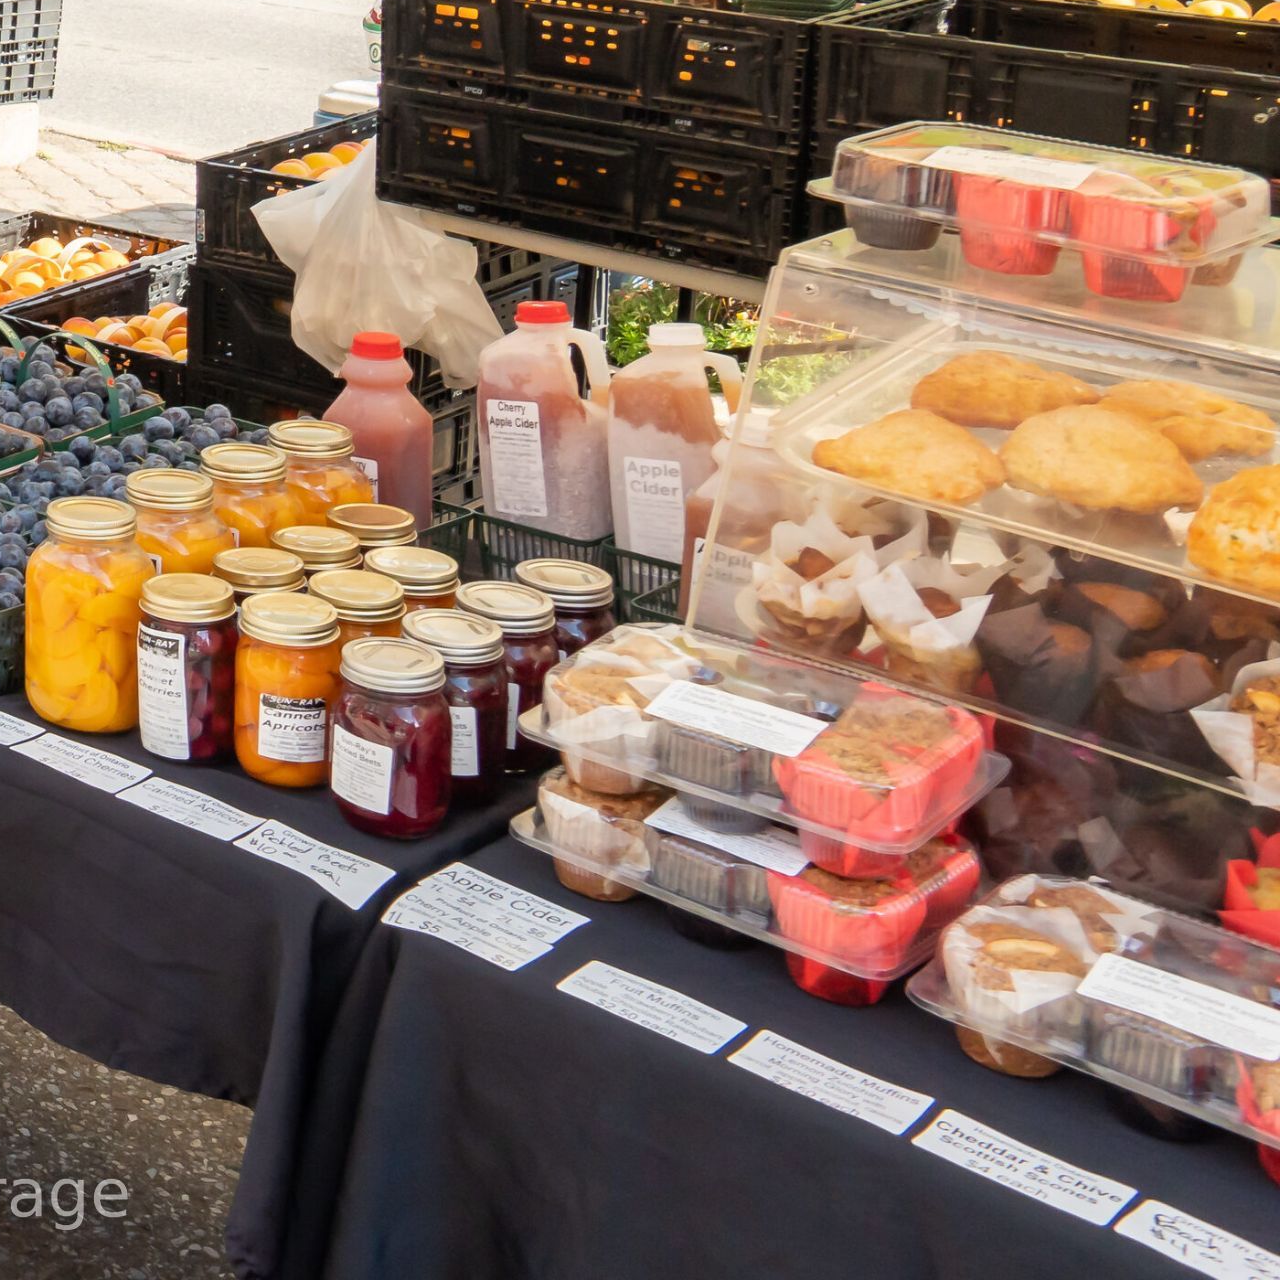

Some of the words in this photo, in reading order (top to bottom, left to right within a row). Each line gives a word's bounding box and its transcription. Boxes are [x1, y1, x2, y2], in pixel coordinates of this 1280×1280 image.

[489, 416, 513, 429] Apple
[515, 417, 539, 429] Cider
[497, 401, 526, 415] Cherry
[627, 461, 680, 478] Apple
[630, 480, 680, 497] Cider
[139, 678, 182, 698] Cherries
[262, 719, 326, 732] Apricots
[264, 708, 322, 720] Canned
[35, 738, 84, 761] Canned
[84, 757, 137, 781] Cherries
[142, 782, 195, 805] Canned
[194, 803, 249, 828] Apricots
[282, 829, 316, 848] Grown
[330, 850, 371, 868] Ontario
[441, 869, 504, 902] Apple
[509, 899, 573, 927] Cider
[465, 870, 509, 892] Product
[524, 894, 567, 915] Ontario
[405, 894, 450, 917] Cherry
[451, 916, 491, 937] Apple
[494, 936, 533, 956] Cider
[418, 920, 443, 933] $5
[435, 897, 476, 920] Product
[489, 922, 528, 942] Ontario
[610, 978, 644, 996] Fruit
[645, 992, 701, 1021] Muffins
[640, 1019, 678, 1038] each
[763, 1035, 856, 1081] Homemade
[860, 1078, 920, 1107] Muffins
[768, 1057, 820, 1084] Morning
[819, 1097, 860, 1117] each
[936, 1120, 1029, 1166] Cheddar
[1057, 1174, 1123, 1203] Chive
[939, 1134, 1019, 1173] Scottish
[1024, 1171, 1099, 1205] Scones
[963, 1159, 990, 1173] $4
[996, 1174, 1049, 1199] each
